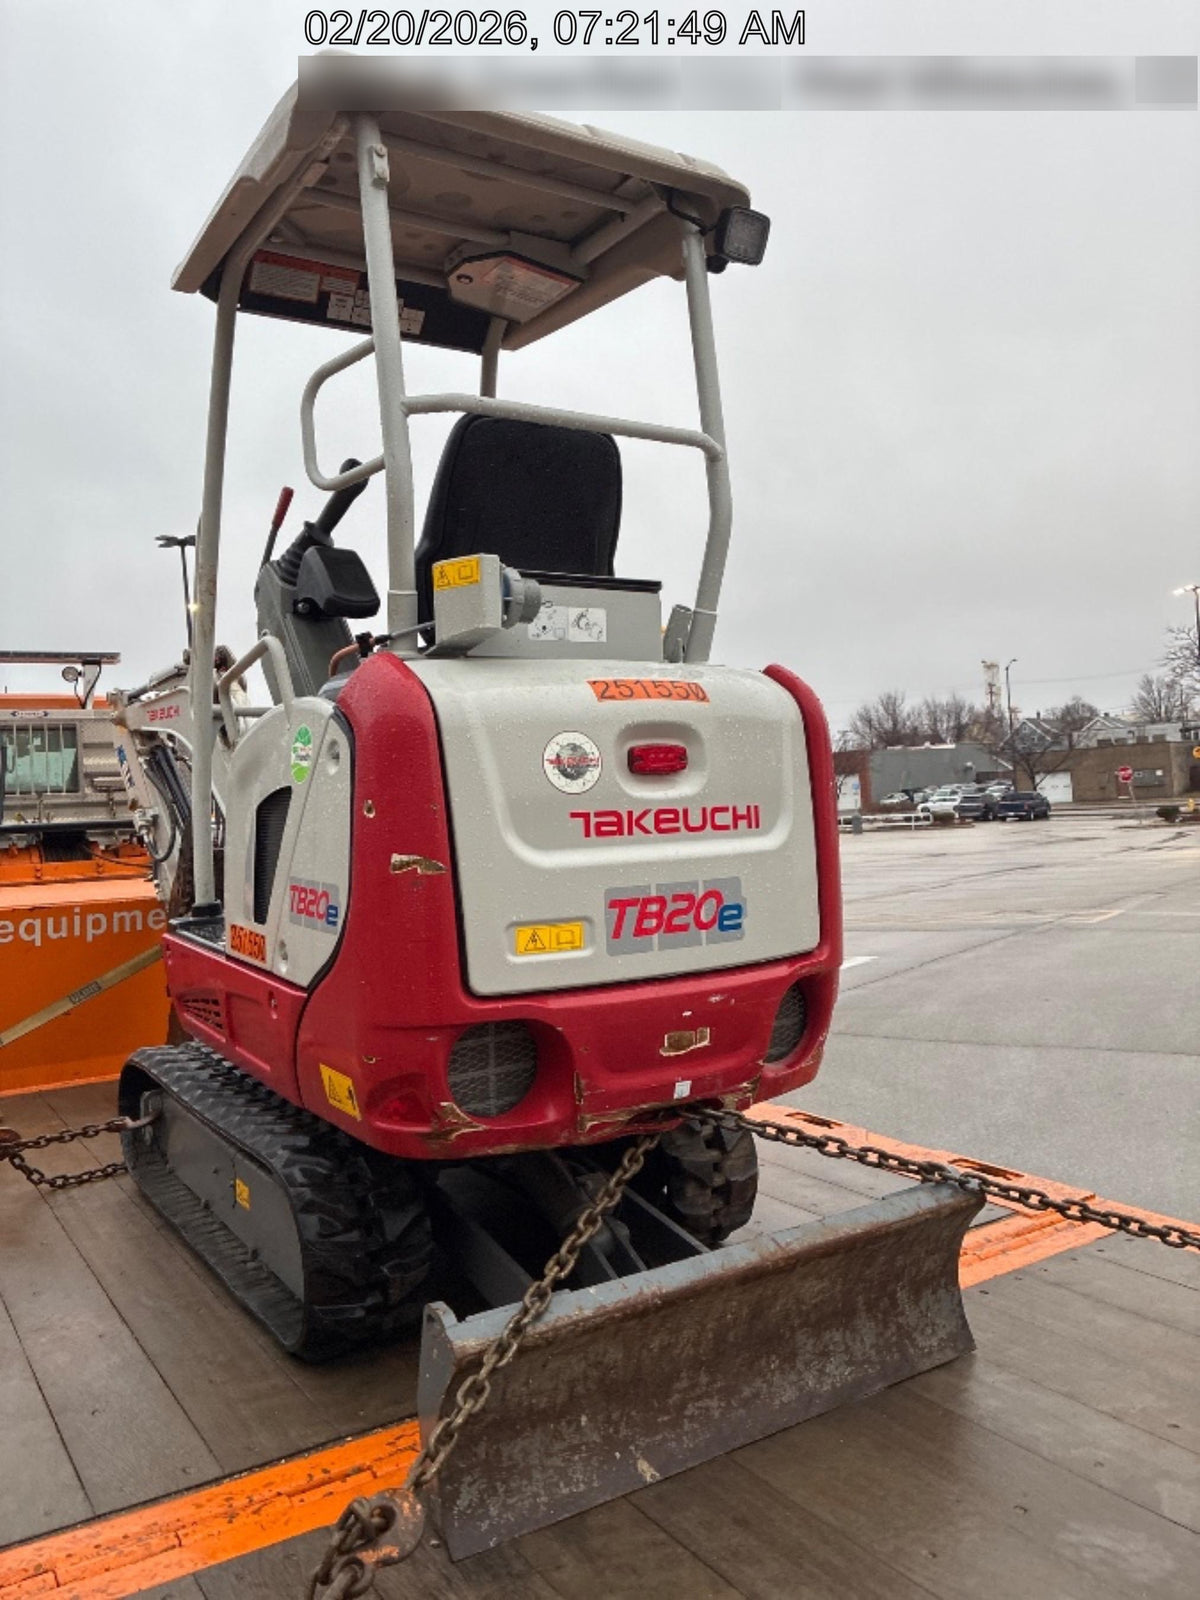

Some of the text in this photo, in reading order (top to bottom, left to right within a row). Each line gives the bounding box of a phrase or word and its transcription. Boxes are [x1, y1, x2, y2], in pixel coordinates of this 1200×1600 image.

[592, 680, 706, 700] 251550
[569, 805, 760, 838] TAKEUCHI
[289, 884, 339, 927] TB20e
[608, 889, 743, 939] TB20e
